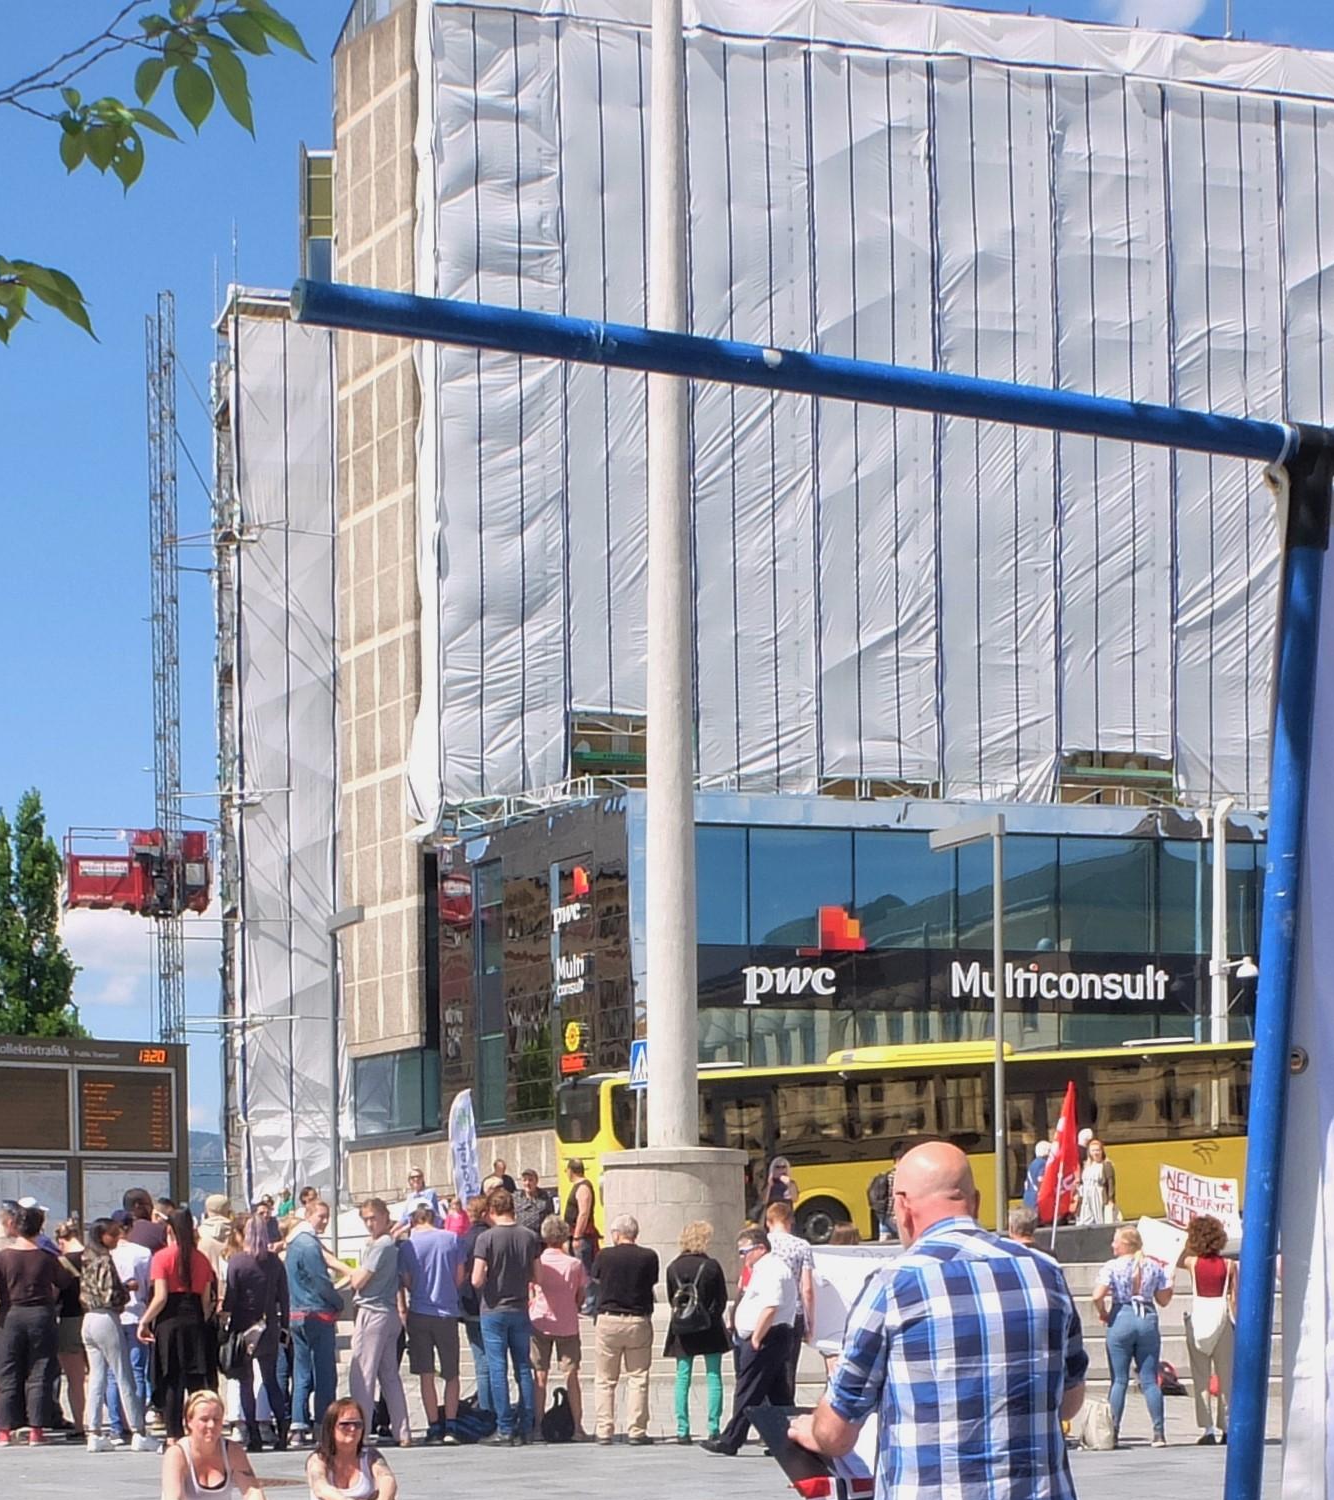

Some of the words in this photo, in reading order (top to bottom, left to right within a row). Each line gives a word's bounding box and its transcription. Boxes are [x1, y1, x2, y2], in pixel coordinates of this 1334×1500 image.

[553, 902, 581, 931] pwc
[742, 965, 836, 1005] pwc
[951, 961, 1168, 1001] Multiconsult
